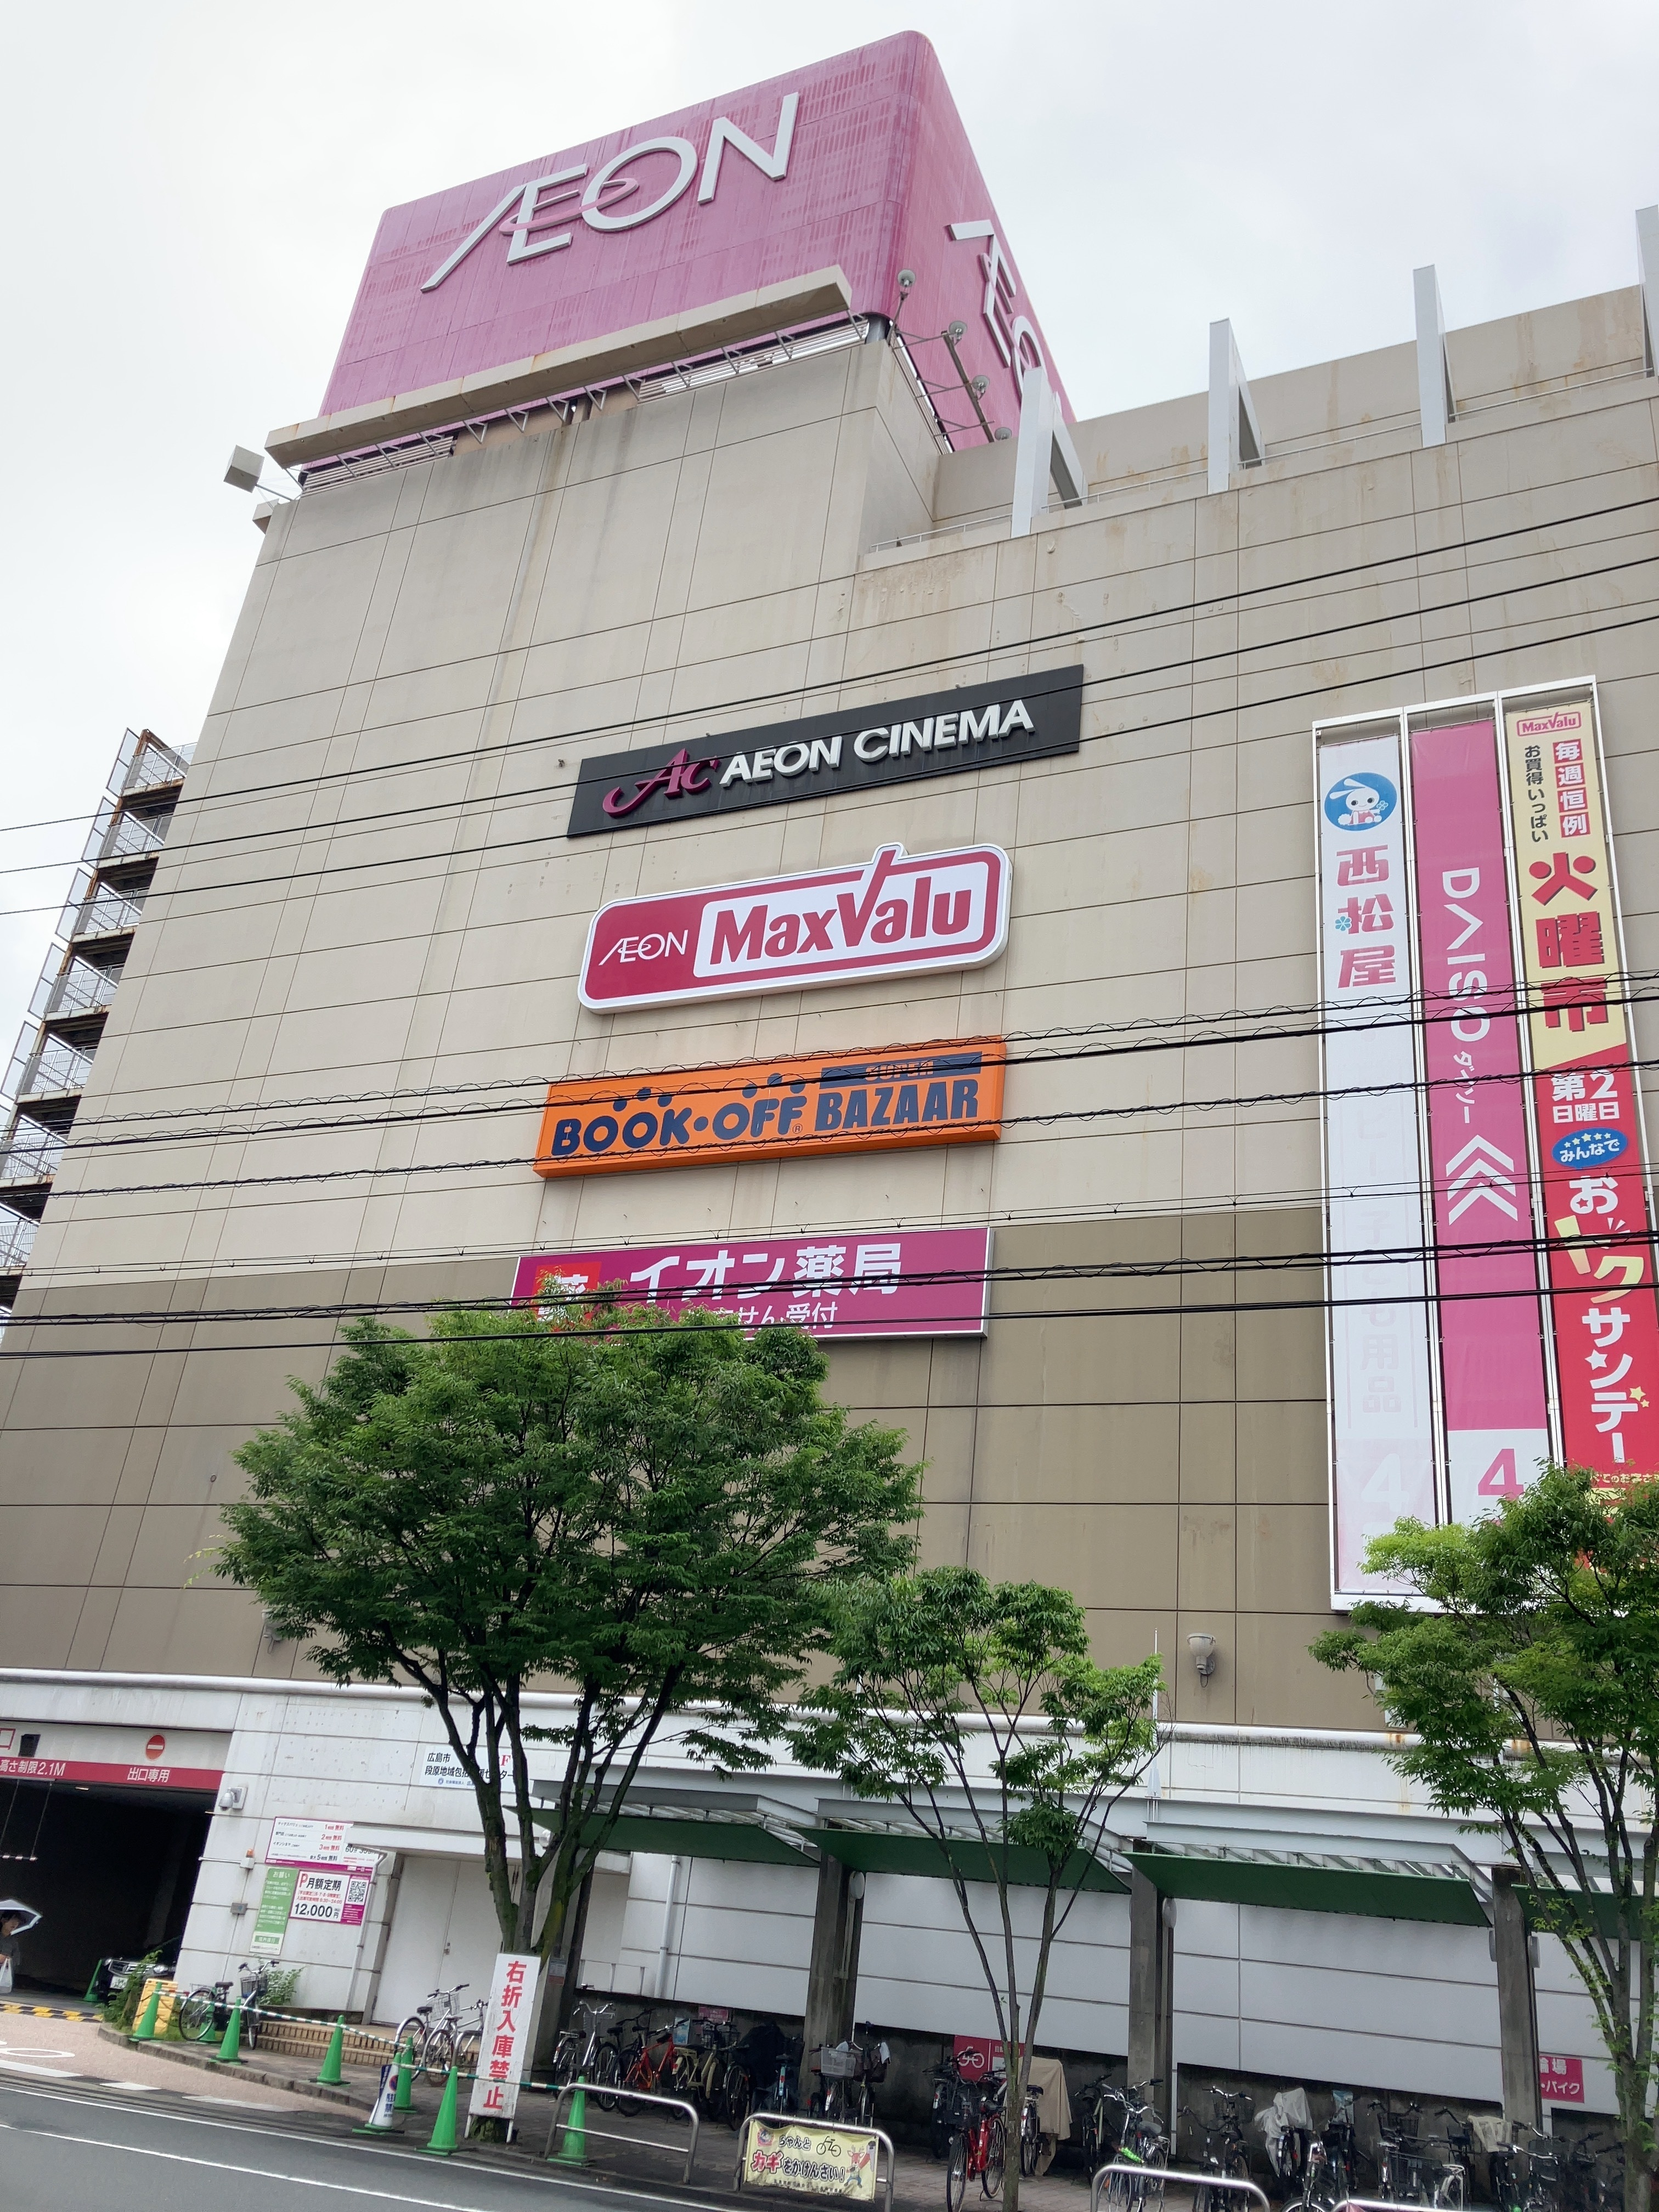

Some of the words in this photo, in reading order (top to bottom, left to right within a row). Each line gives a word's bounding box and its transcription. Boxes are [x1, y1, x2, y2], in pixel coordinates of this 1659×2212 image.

[719, 735, 842, 788] AEON
[853, 699, 1037, 763] CINEMA
[1522, 712, 1577, 733] MaxValu
[1525, 744, 1549, 843] お買得いっぱい
[1555, 741, 1587, 836] 毎週恒例
[708, 850, 973, 966] MaxValu
[1335, 844, 1396, 988] 西松屋
[1529, 852, 1609, 1032] 火曜市
[814, 1079, 978, 1132] BAZAAR
[1550, 1069, 1618, 1102] 第2
[1552, 1101, 1621, 1124] 日曜日
[1559, 1138, 1621, 1163] みんなで
[630, 1243, 901, 1304] イオン薬局
[0, 1759, 66, 1776] 高さ制限2.1M
[127, 1767, 171, 1784] 出口専用
[427, 1752, 451, 1763] 広島市
[295, 1902, 332, 1918] 12,000
[483, 1960, 527, 2110] 右折入庫禁止
